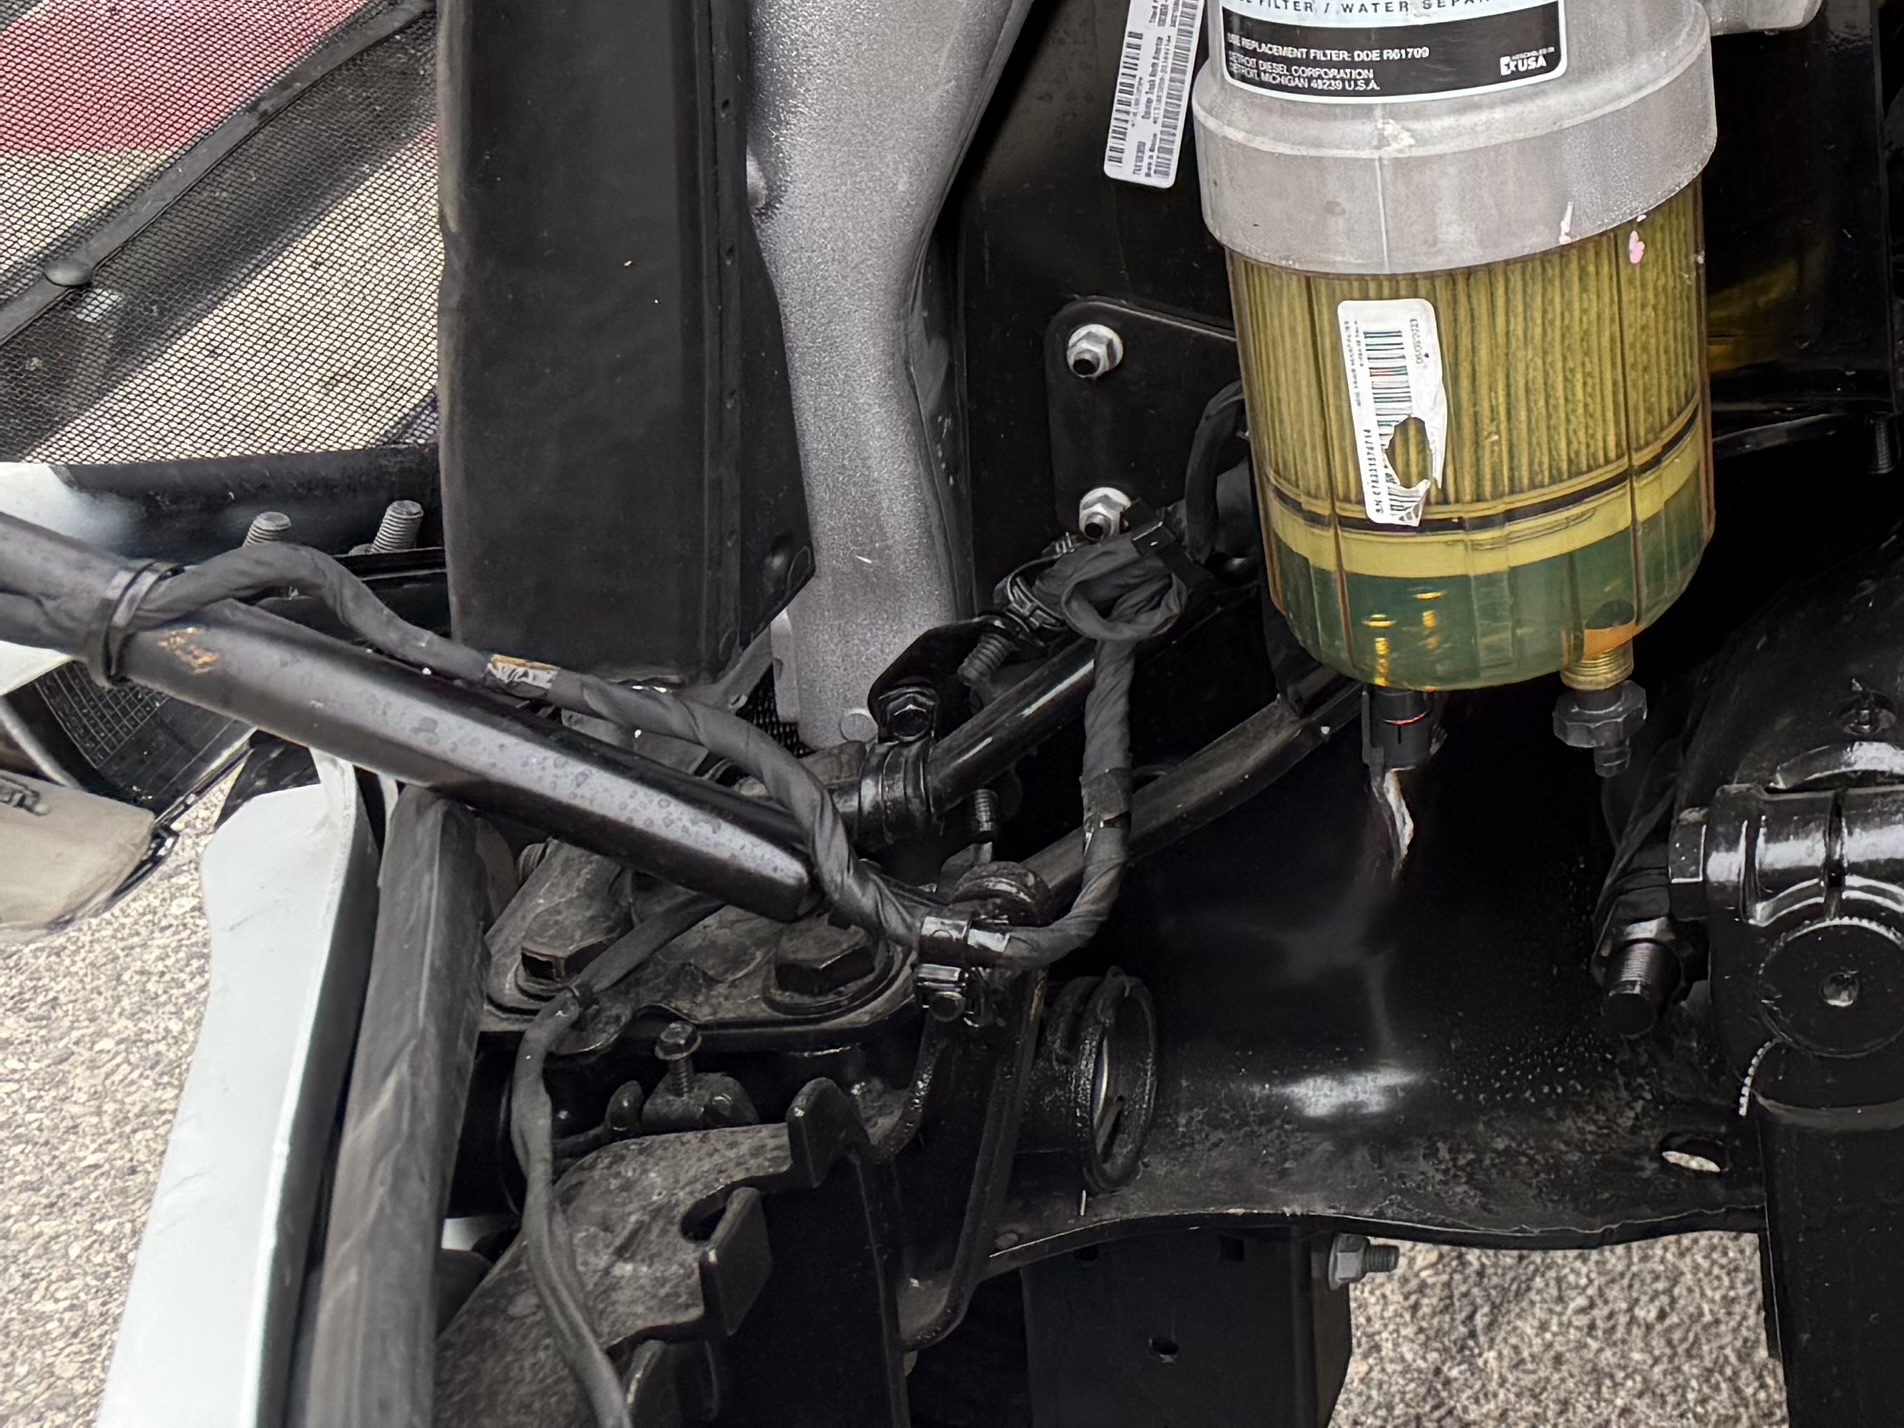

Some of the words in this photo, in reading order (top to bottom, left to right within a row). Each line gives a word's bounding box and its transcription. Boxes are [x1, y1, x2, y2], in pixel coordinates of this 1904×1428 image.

[1341, 1, 1409, 14] WATER
[1310, 48, 1351, 61] FILTER:
[1354, 50, 1381, 62] DDE
[1259, 59, 1289, 74] DIESEL
[1292, 66, 1373, 79] CORPORATION
[1520, 56, 1547, 72] USA
[1261, 71, 1309, 89] MICHIGAN
